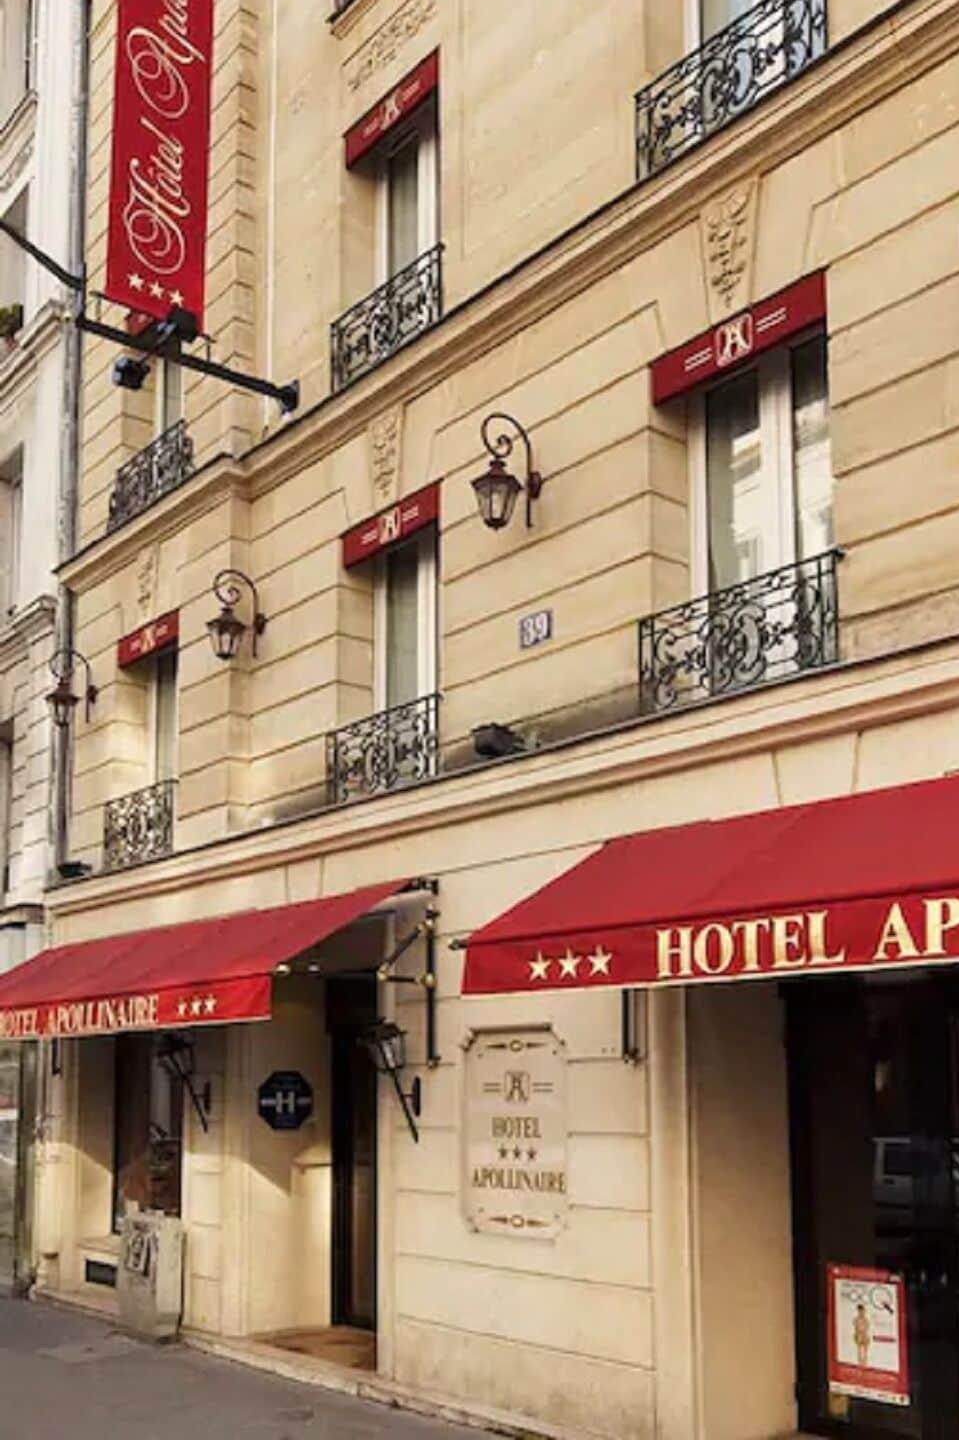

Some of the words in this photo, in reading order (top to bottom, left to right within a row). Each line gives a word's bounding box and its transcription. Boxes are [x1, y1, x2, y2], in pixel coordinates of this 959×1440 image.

[655, 910, 845, 979] HOTEL
[45, 994, 160, 1035] APOLLINAIRE
[491, 1116, 542, 1139] HOTEL
[471, 1167, 567, 1195] APOLLINAIRE
